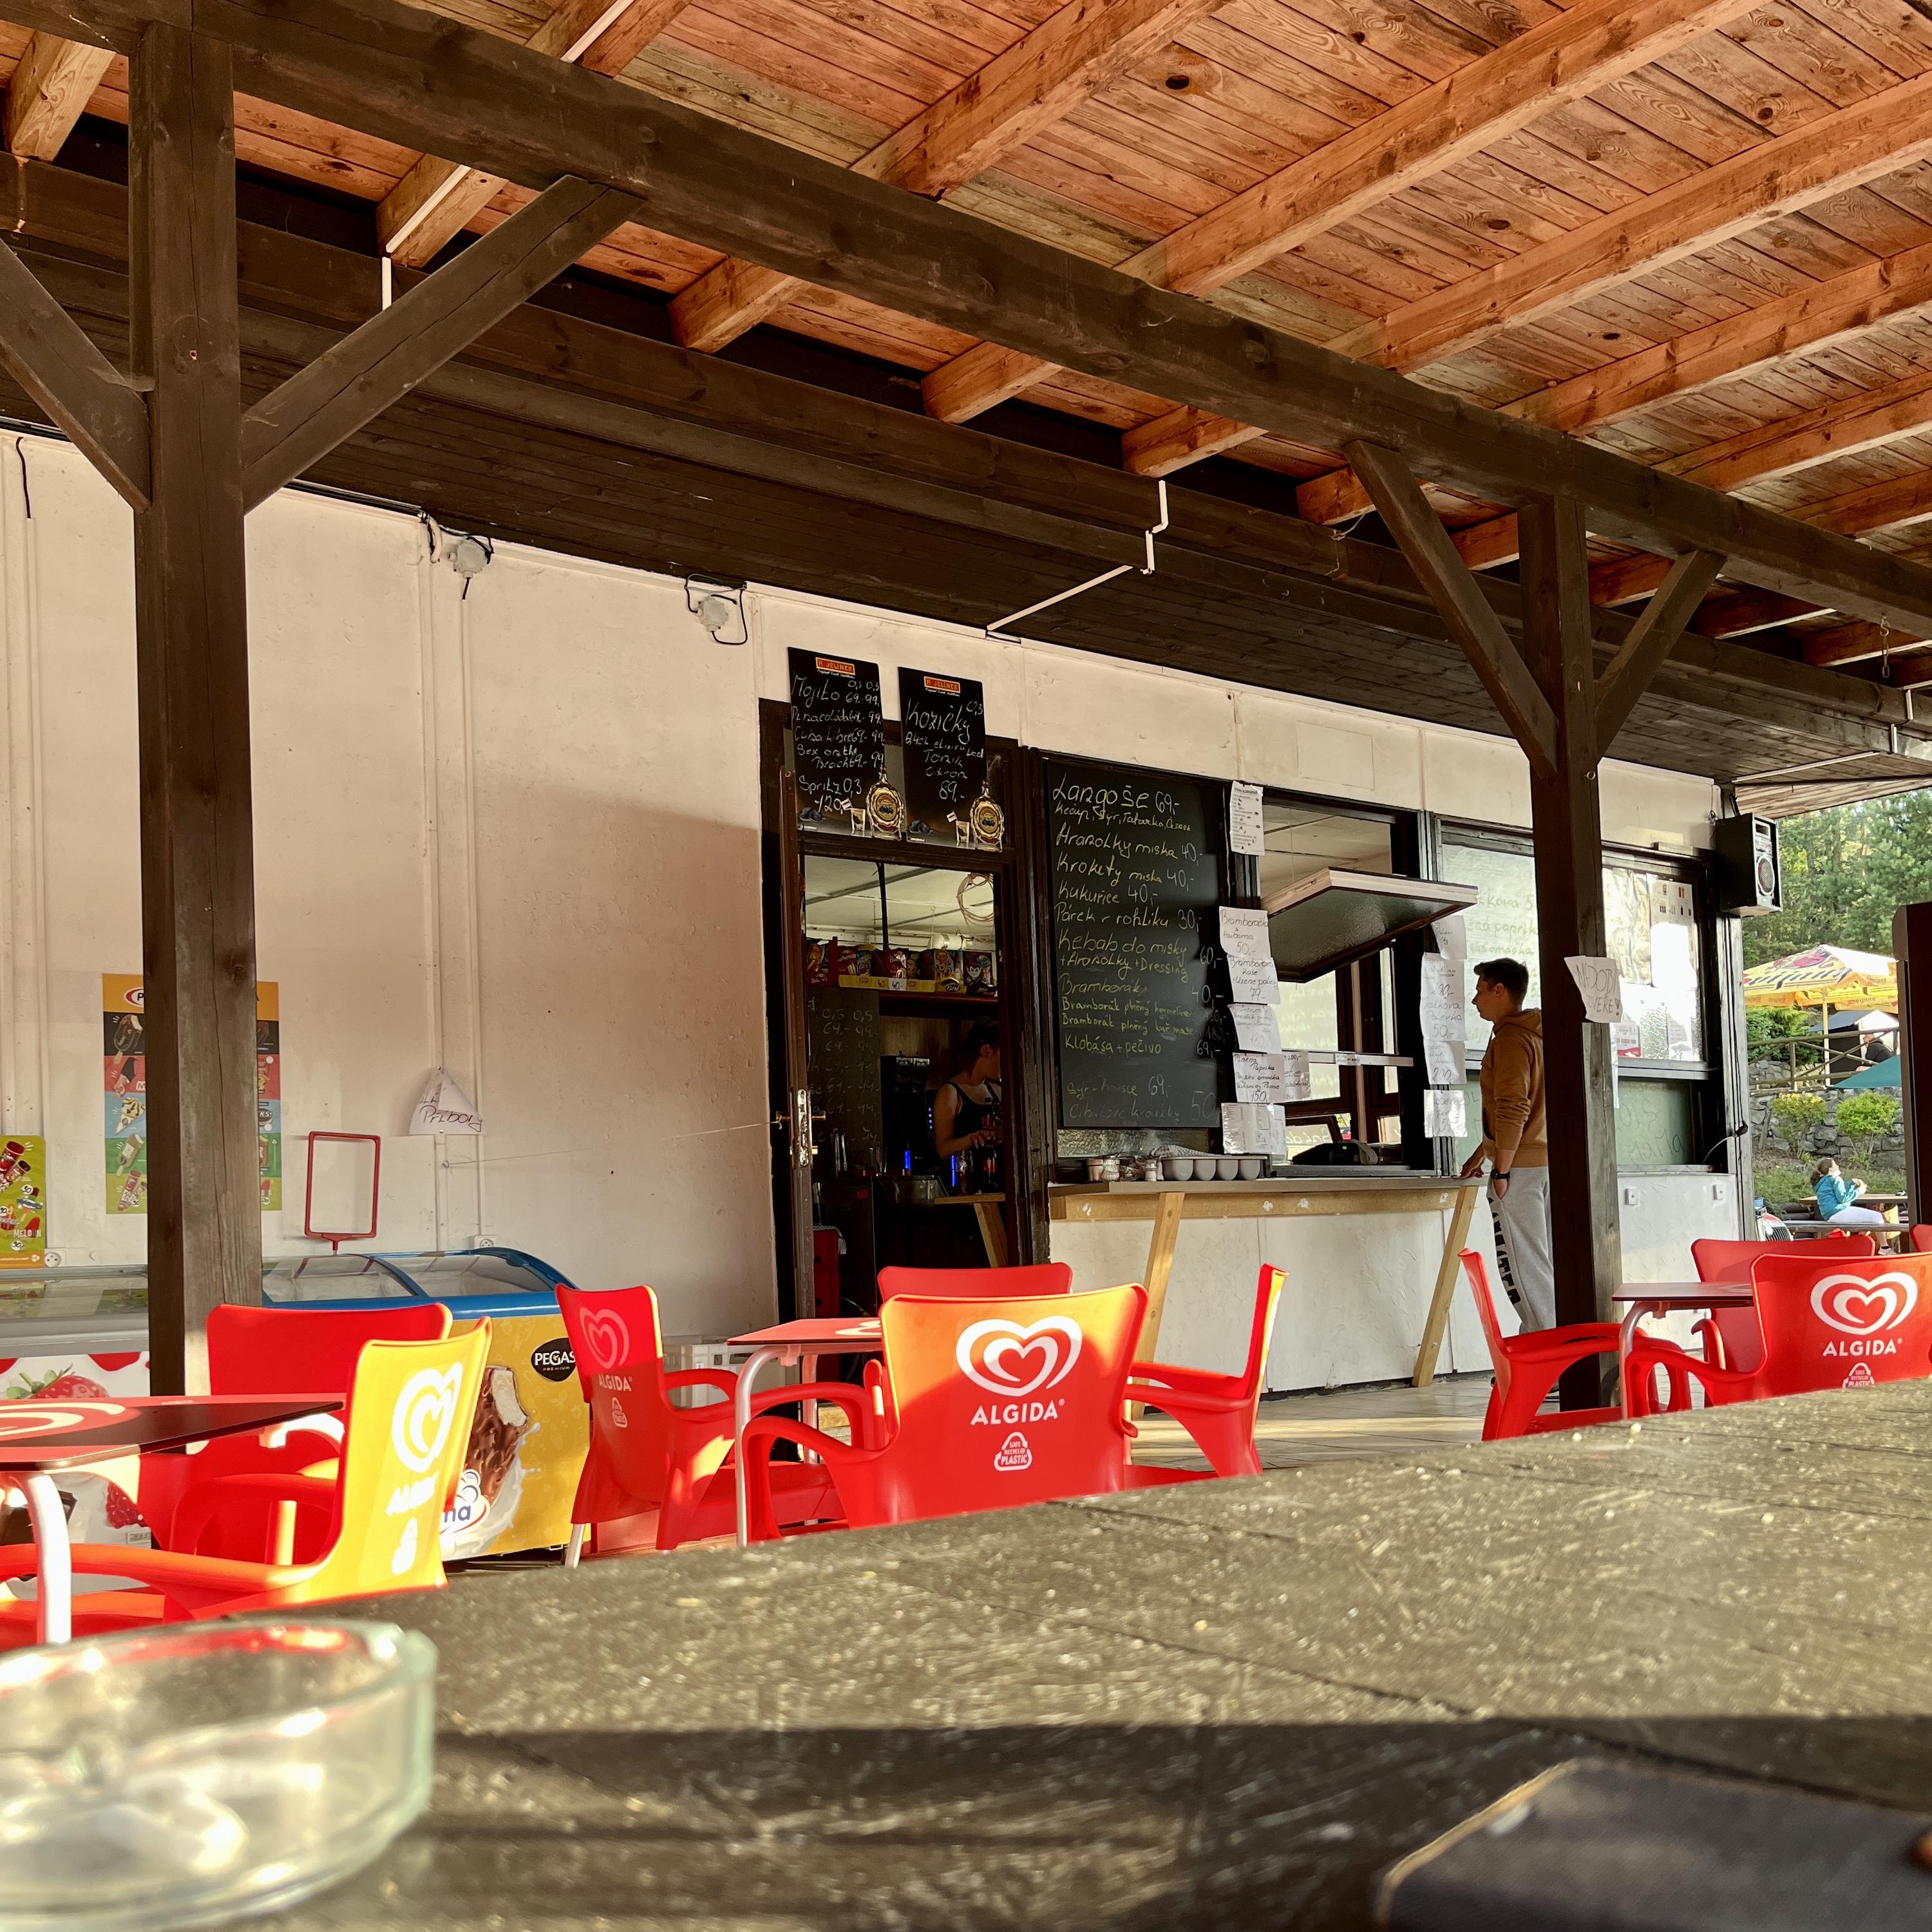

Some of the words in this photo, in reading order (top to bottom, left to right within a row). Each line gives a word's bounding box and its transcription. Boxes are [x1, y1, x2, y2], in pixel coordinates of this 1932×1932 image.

[1052, 772, 1150, 809] Langoše
[1057, 851, 1122, 887] Krokety
[1122, 936, 1146, 954] do
[1065, 1032, 1115, 1054] Klobása
[1822, 1339, 1897, 1357] ALGIDA
[598, 1372, 632, 1392] ALGIDA
[970, 1399, 1058, 1426] ALGIDA
[1001, 1454, 1028, 1466] PLASTIC
